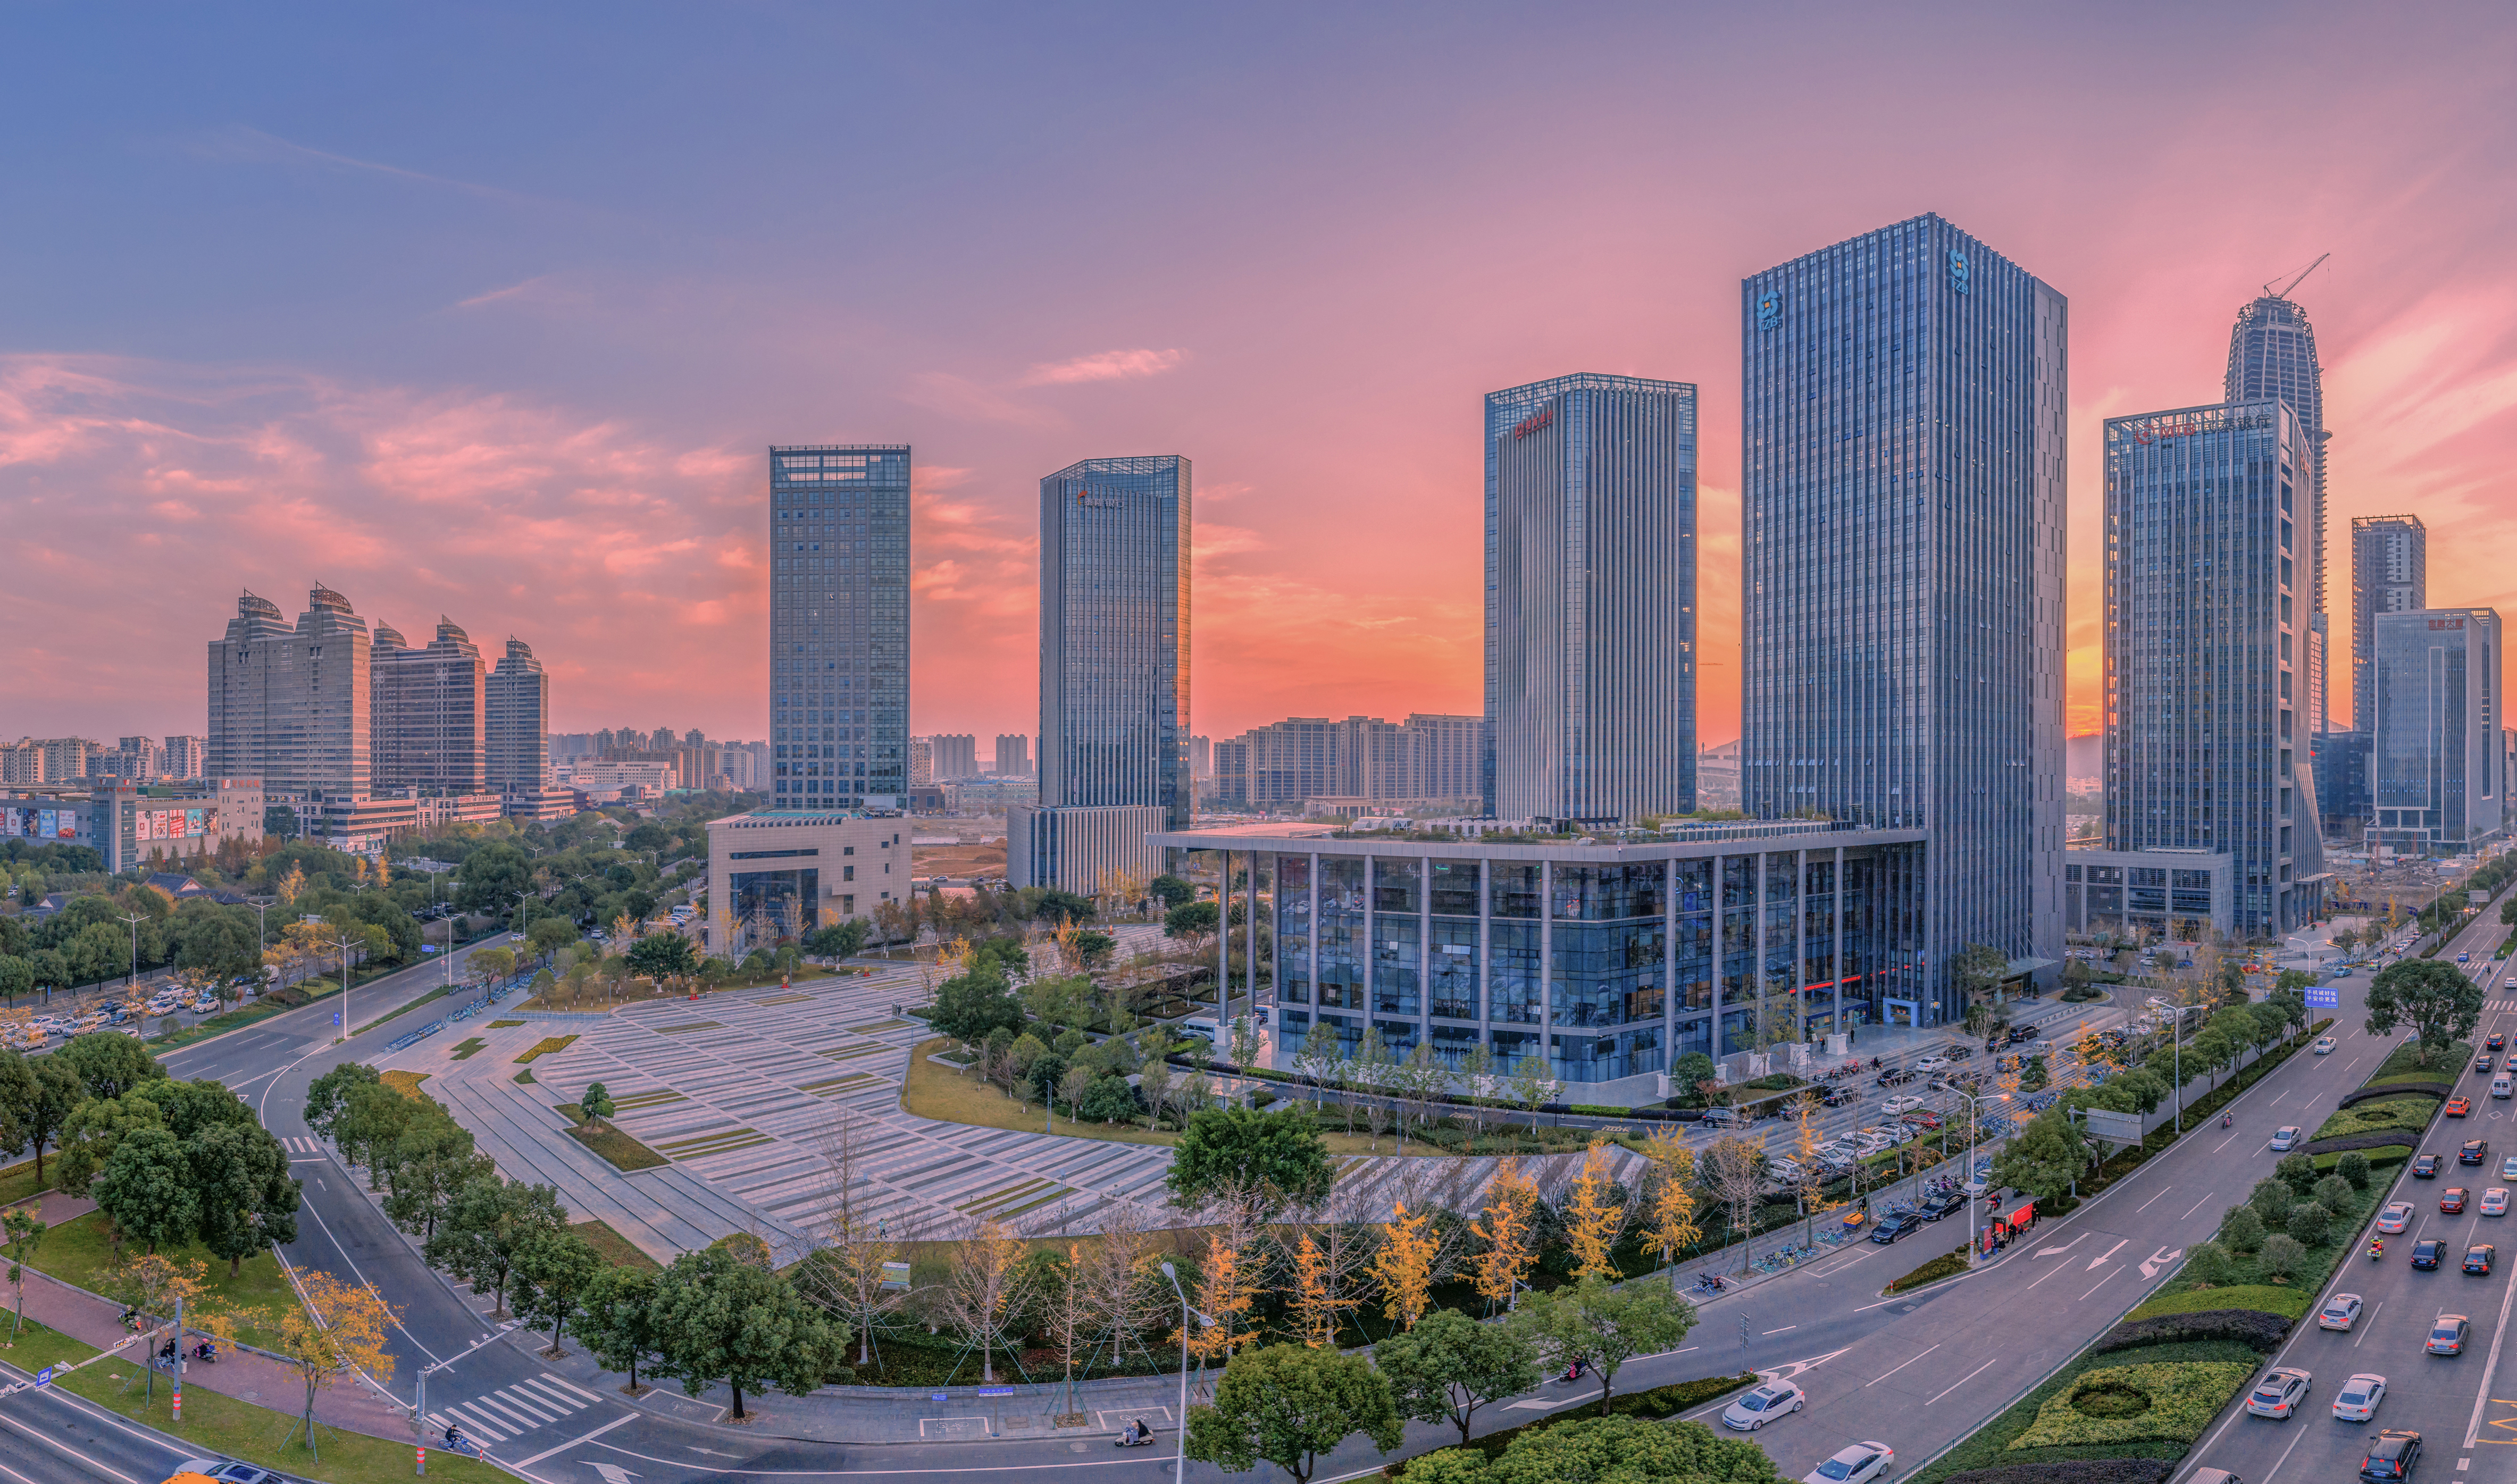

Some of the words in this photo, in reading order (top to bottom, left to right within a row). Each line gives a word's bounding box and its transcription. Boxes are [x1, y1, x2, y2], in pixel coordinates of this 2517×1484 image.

[1950, 276, 1968, 295] TZB
[1757, 316, 1778, 331] TZB
[1526, 410, 1553, 430] 招商银行
[2160, 423, 2195, 439] MTB
[2202, 414, 2271, 434] 民泰银行
[1084, 498, 1125, 507] 泰隆银行
[2428, 619, 2463, 627] 金融大厦
